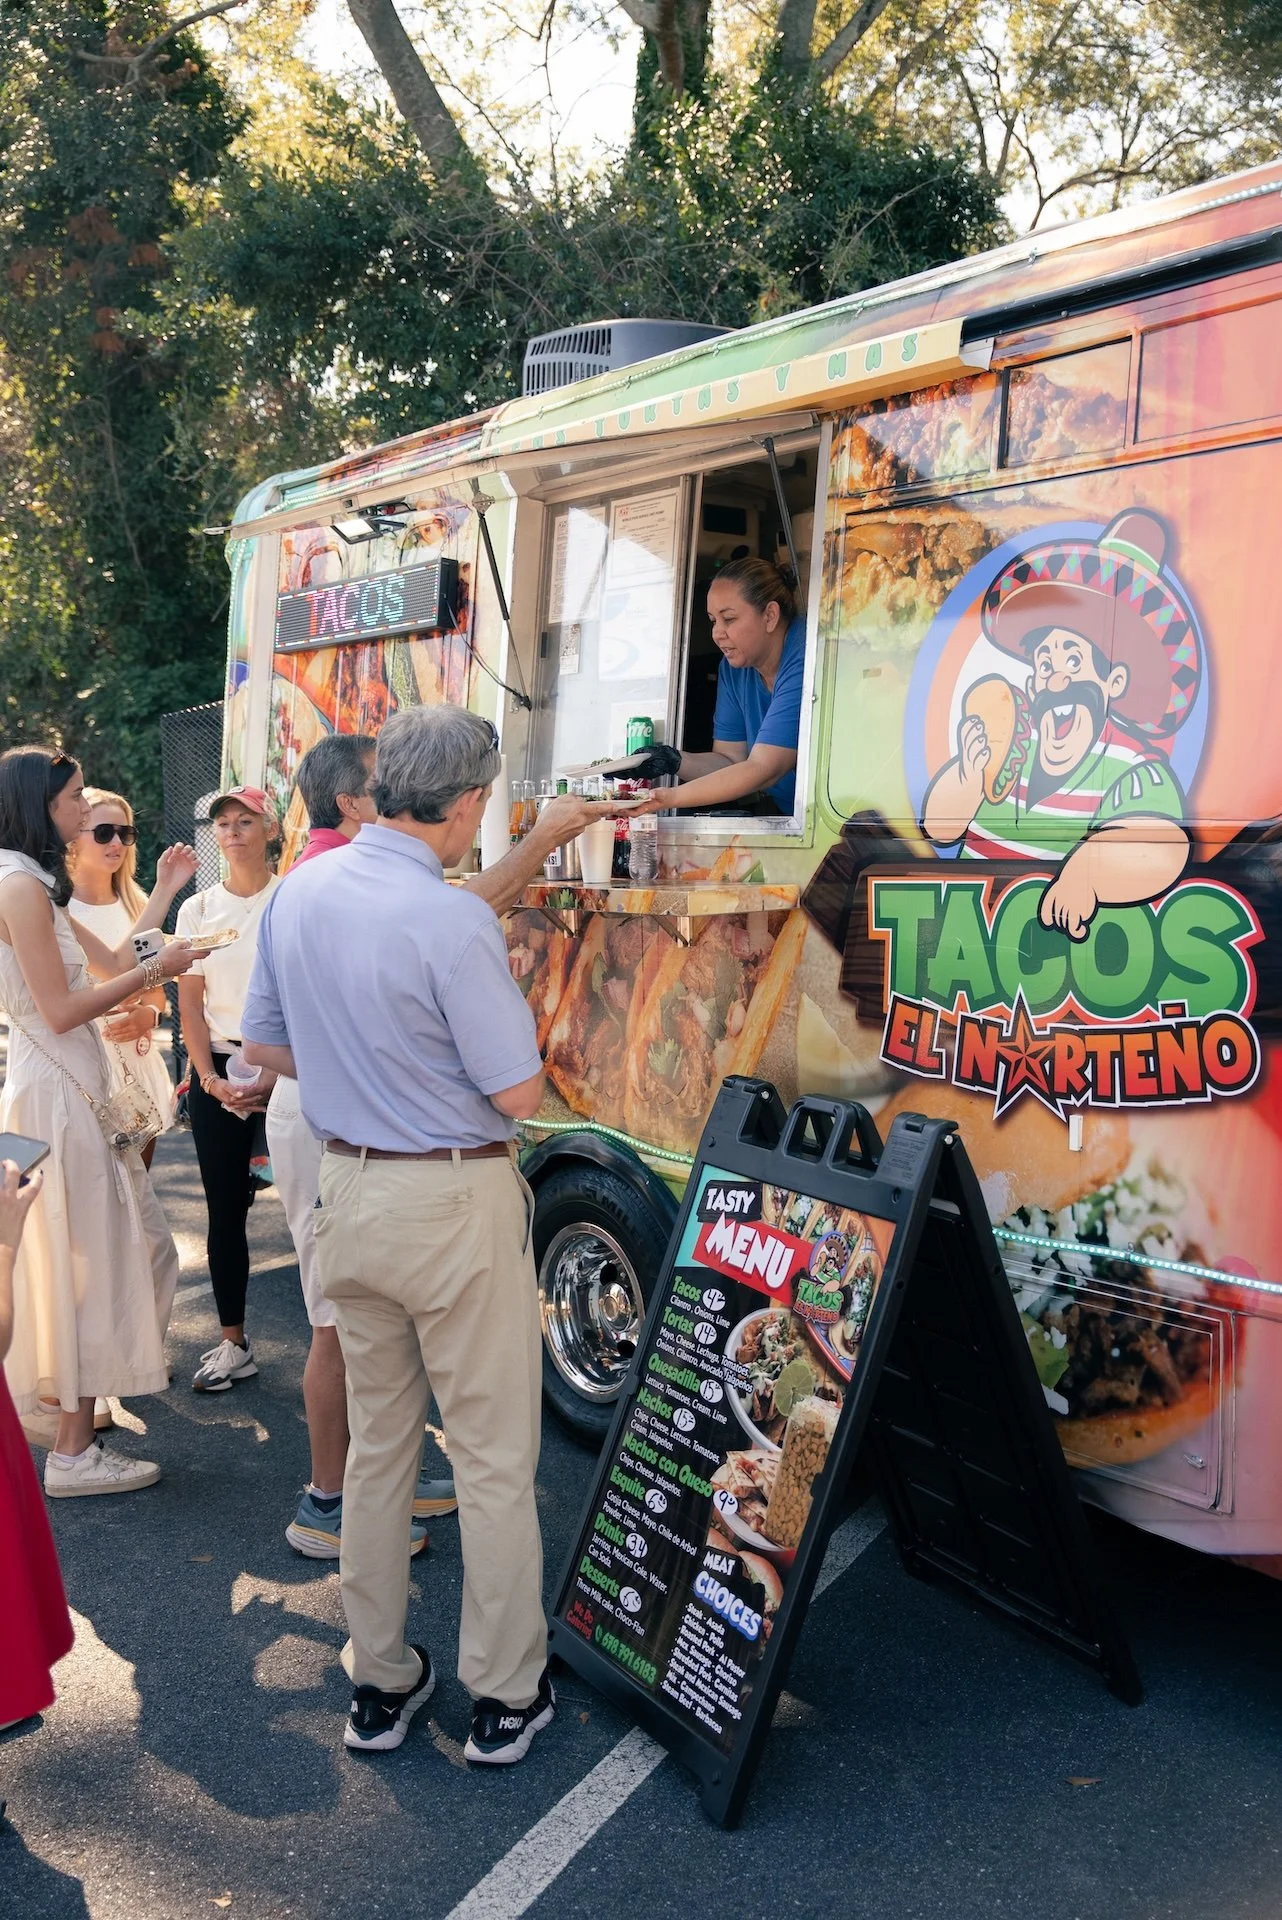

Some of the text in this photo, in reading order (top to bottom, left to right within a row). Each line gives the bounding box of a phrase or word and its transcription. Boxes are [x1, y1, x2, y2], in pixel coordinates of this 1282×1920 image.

[775, 362, 791, 393] Y
[826, 331, 918, 381] MAS
[307, 575, 405, 636] TACOS
[874, 880, 1250, 1018] TACOS
[882, 998, 943, 1075] EL
[706, 1188, 755, 1214] TASTY
[705, 1211, 795, 1288] MENU
[673, 1276, 701, 1301] Tacos
[799, 1282, 843, 1311] TACOS
[663, 1307, 694, 1334] Tortas
[694, 1306, 714, 1322] Onions,
[716, 1315, 730, 1328] Lime
[656, 1338, 675, 1355] Onions,
[676, 1348, 698, 1366] Cilantro,
[699, 1360, 726, 1379] Avocado,
[660, 1327, 674, 1341] Mayo,
[676, 1335, 695, 1351] Cheese,
[697, 1344, 719, 1363] Lechuga,
[649, 1353, 700, 1392] Quesadilla
[637, 1387, 673, 1418] Nachos
[646, 1374, 664, 1392] Lettuce,
[666, 1385, 690, 1406] Tomatoes,
[692, 1399, 711, 1417] Cream,
[712, 1409, 727, 1424] Lime
[631, 1419, 647, 1436] Cream,
[635, 1408, 649, 1423] Chips,
[650, 1417, 669, 1435] Cheese,
[670, 1428, 691, 1448] Lettuce,
[693, 1440, 719, 1464] Tomatoes,
[610, 1465, 645, 1500] Esquite
[620, 1452, 634, 1468] Chips,
[635, 1462, 654, 1481] Cheese,
[622, 1431, 716, 1497] Nachos con Queso
[595, 1512, 625, 1546] Drinks
[603, 1501, 622, 1522] Powder,
[622, 1500, 640, 1520] Cheese,
[641, 1513, 656, 1531] Mayo,
[658, 1524, 672, 1540] Chile
[671, 1534, 680, 1545] de
[680, 1539, 697, 1556] Arbol
[580, 1556, 619, 1597] Desserts
[589, 1544, 611, 1568] Can Soda.
[592, 1533, 667, 1594] Jarritos, Mexican Coke, Water,
[703, 1551, 736, 1576] MEAT
[577, 1577, 644, 1636] Three Milk cake, Choco-Flan
[687, 1603, 703, 1619] Steak
[706, 1617, 725, 1635] Asada
[694, 1570, 762, 1638] CHOICES
[680, 1625, 703, 1646] Roasted
[702, 1641, 715, 1656] Pork
[718, 1653, 727, 1665] Al
[727, 1659, 745, 1678] Pastor
[684, 1614, 705, 1635] Chicken
[709, 1632, 724, 1648] Pollo
[602, 1633, 656, 1683] 678.791.6183
[673, 1647, 699, 1672] Shredded
[699, 1666, 712, 1682] Pork
[714, 1679, 738, 1702] Carnitas
[689, 1645, 712, 1668] Sausage
[715, 1665, 737, 1686] Chorizo
[662, 1680, 679, 1699] Steam
[679, 1693, 693, 1709] Beef
[696, 1707, 722, 1734] Barbacoa
[666, 1670, 677, 1683] Mix
[681, 1681, 715, 1713] Campechano
[670, 1658, 741, 1719] Steak and Mexican Sausage
